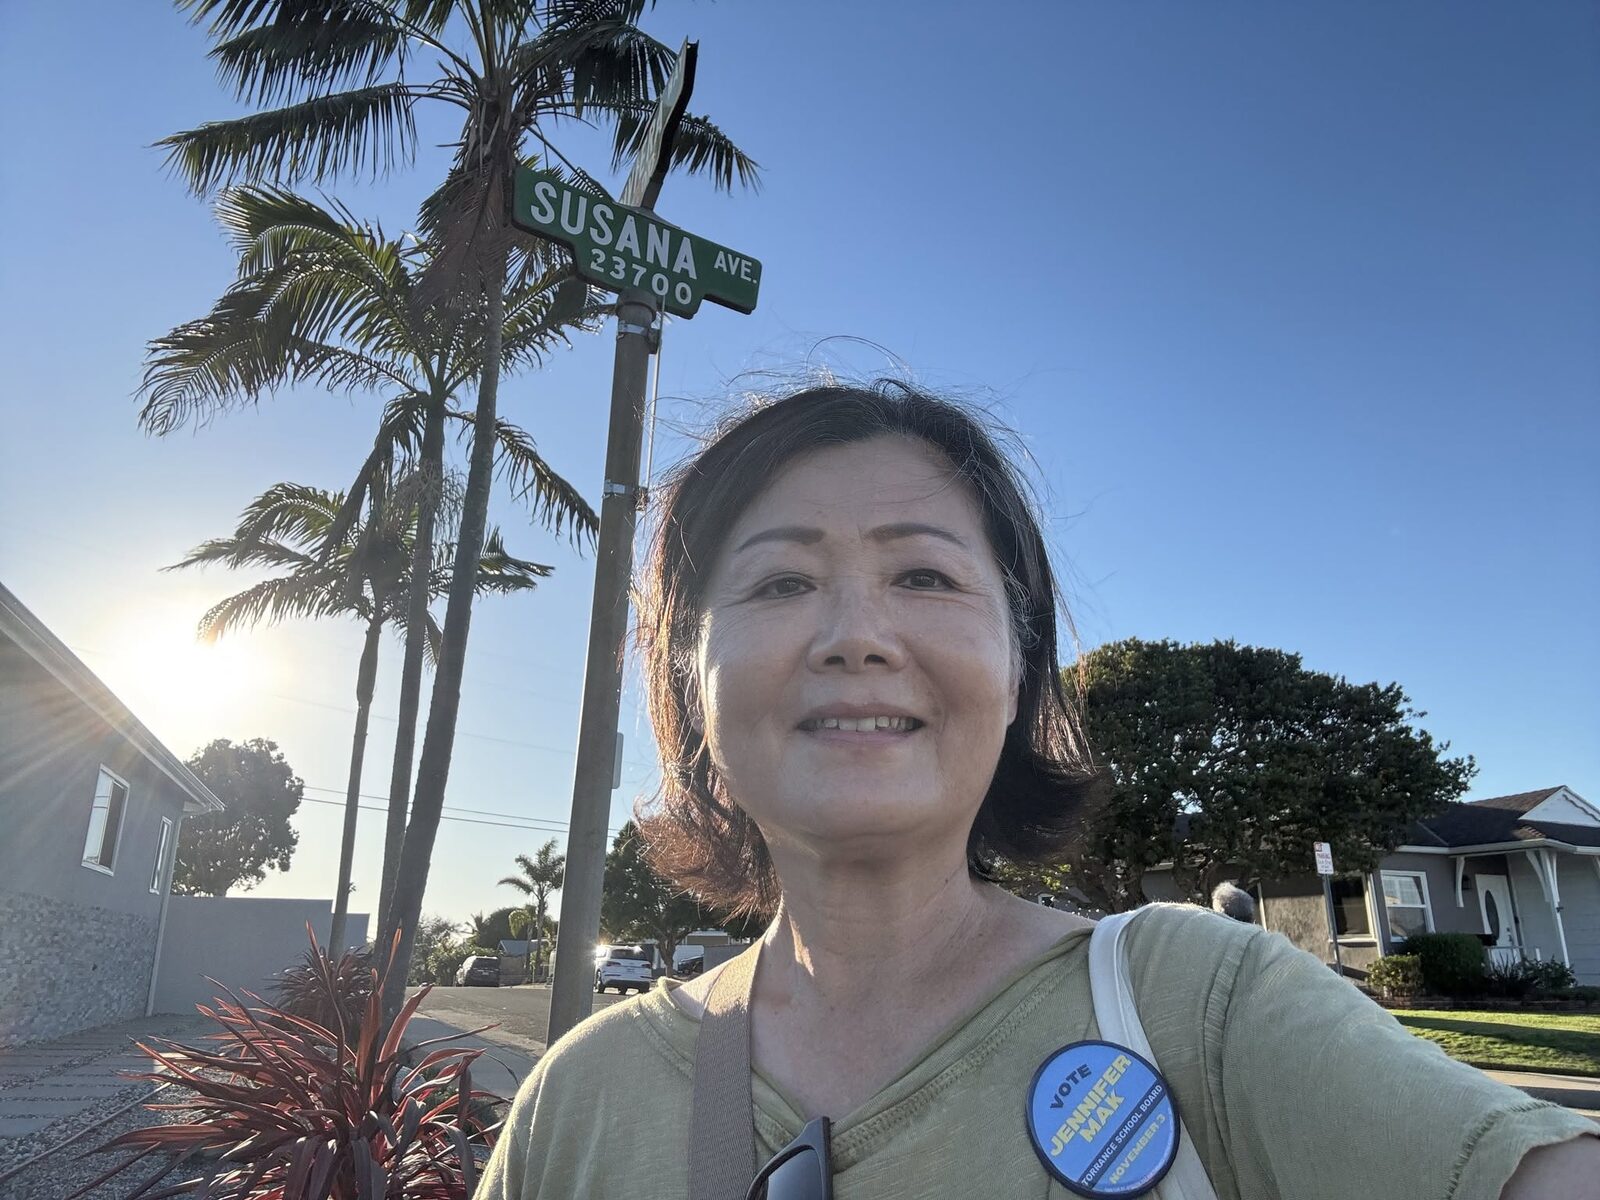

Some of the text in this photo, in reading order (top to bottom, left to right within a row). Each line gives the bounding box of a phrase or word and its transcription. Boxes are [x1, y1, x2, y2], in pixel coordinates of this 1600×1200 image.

[530, 181, 758, 284] SUSANA AVE.
[590, 248, 692, 305] 23700
[1050, 1063, 1092, 1109] VOTE
[1050, 1054, 1132, 1157] JENNIFER
[1079, 1089, 1125, 1143] MAK
[1081, 1143, 1118, 1187] TORRANCE
[1116, 1112, 1143, 1144] SCHOOL
[1140, 1084, 1163, 1113] BOARD
[1109, 1124, 1160, 1184] NOVEMBER
[1158, 1113, 1166, 1124] 3
